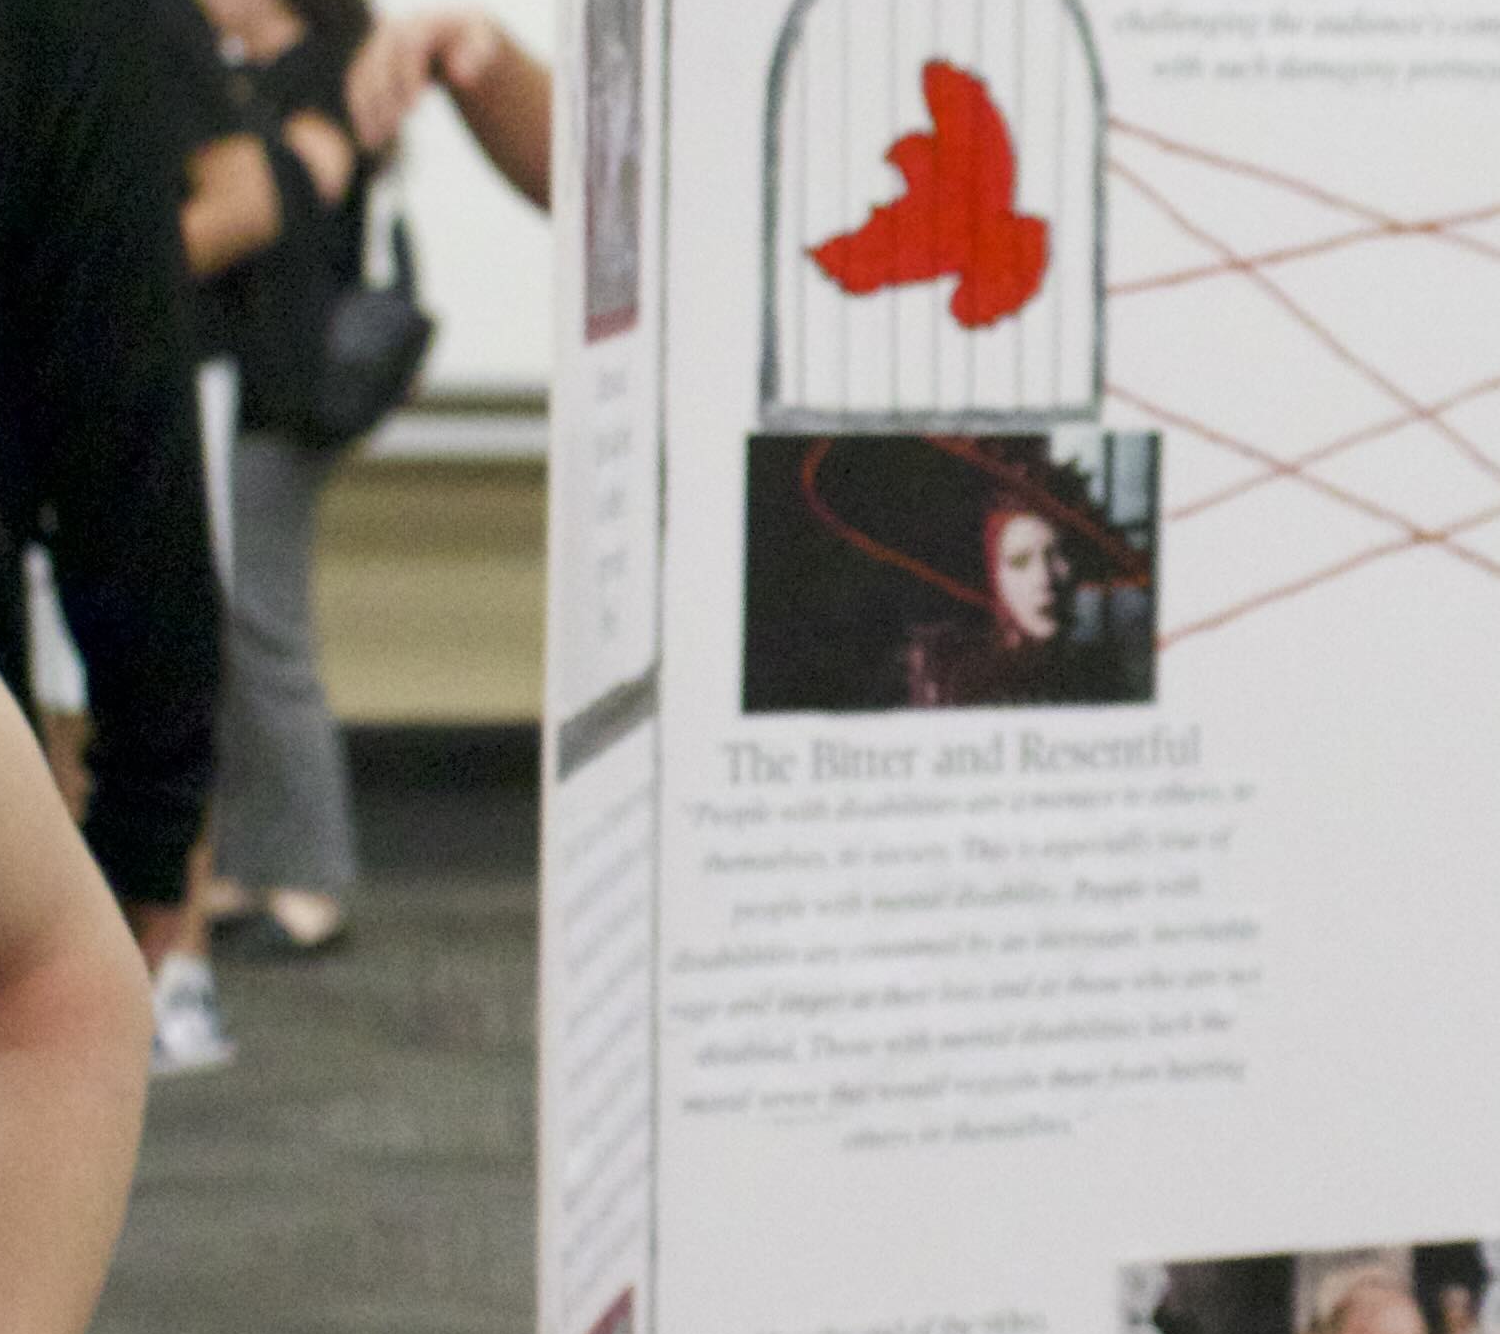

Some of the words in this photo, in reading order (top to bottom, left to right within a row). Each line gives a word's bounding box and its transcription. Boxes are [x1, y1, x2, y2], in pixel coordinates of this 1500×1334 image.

[722, 738, 792, 786] The
[810, 736, 916, 782] Bitter
[933, 731, 1004, 777] and
[1018, 724, 1203, 773] Resentful
